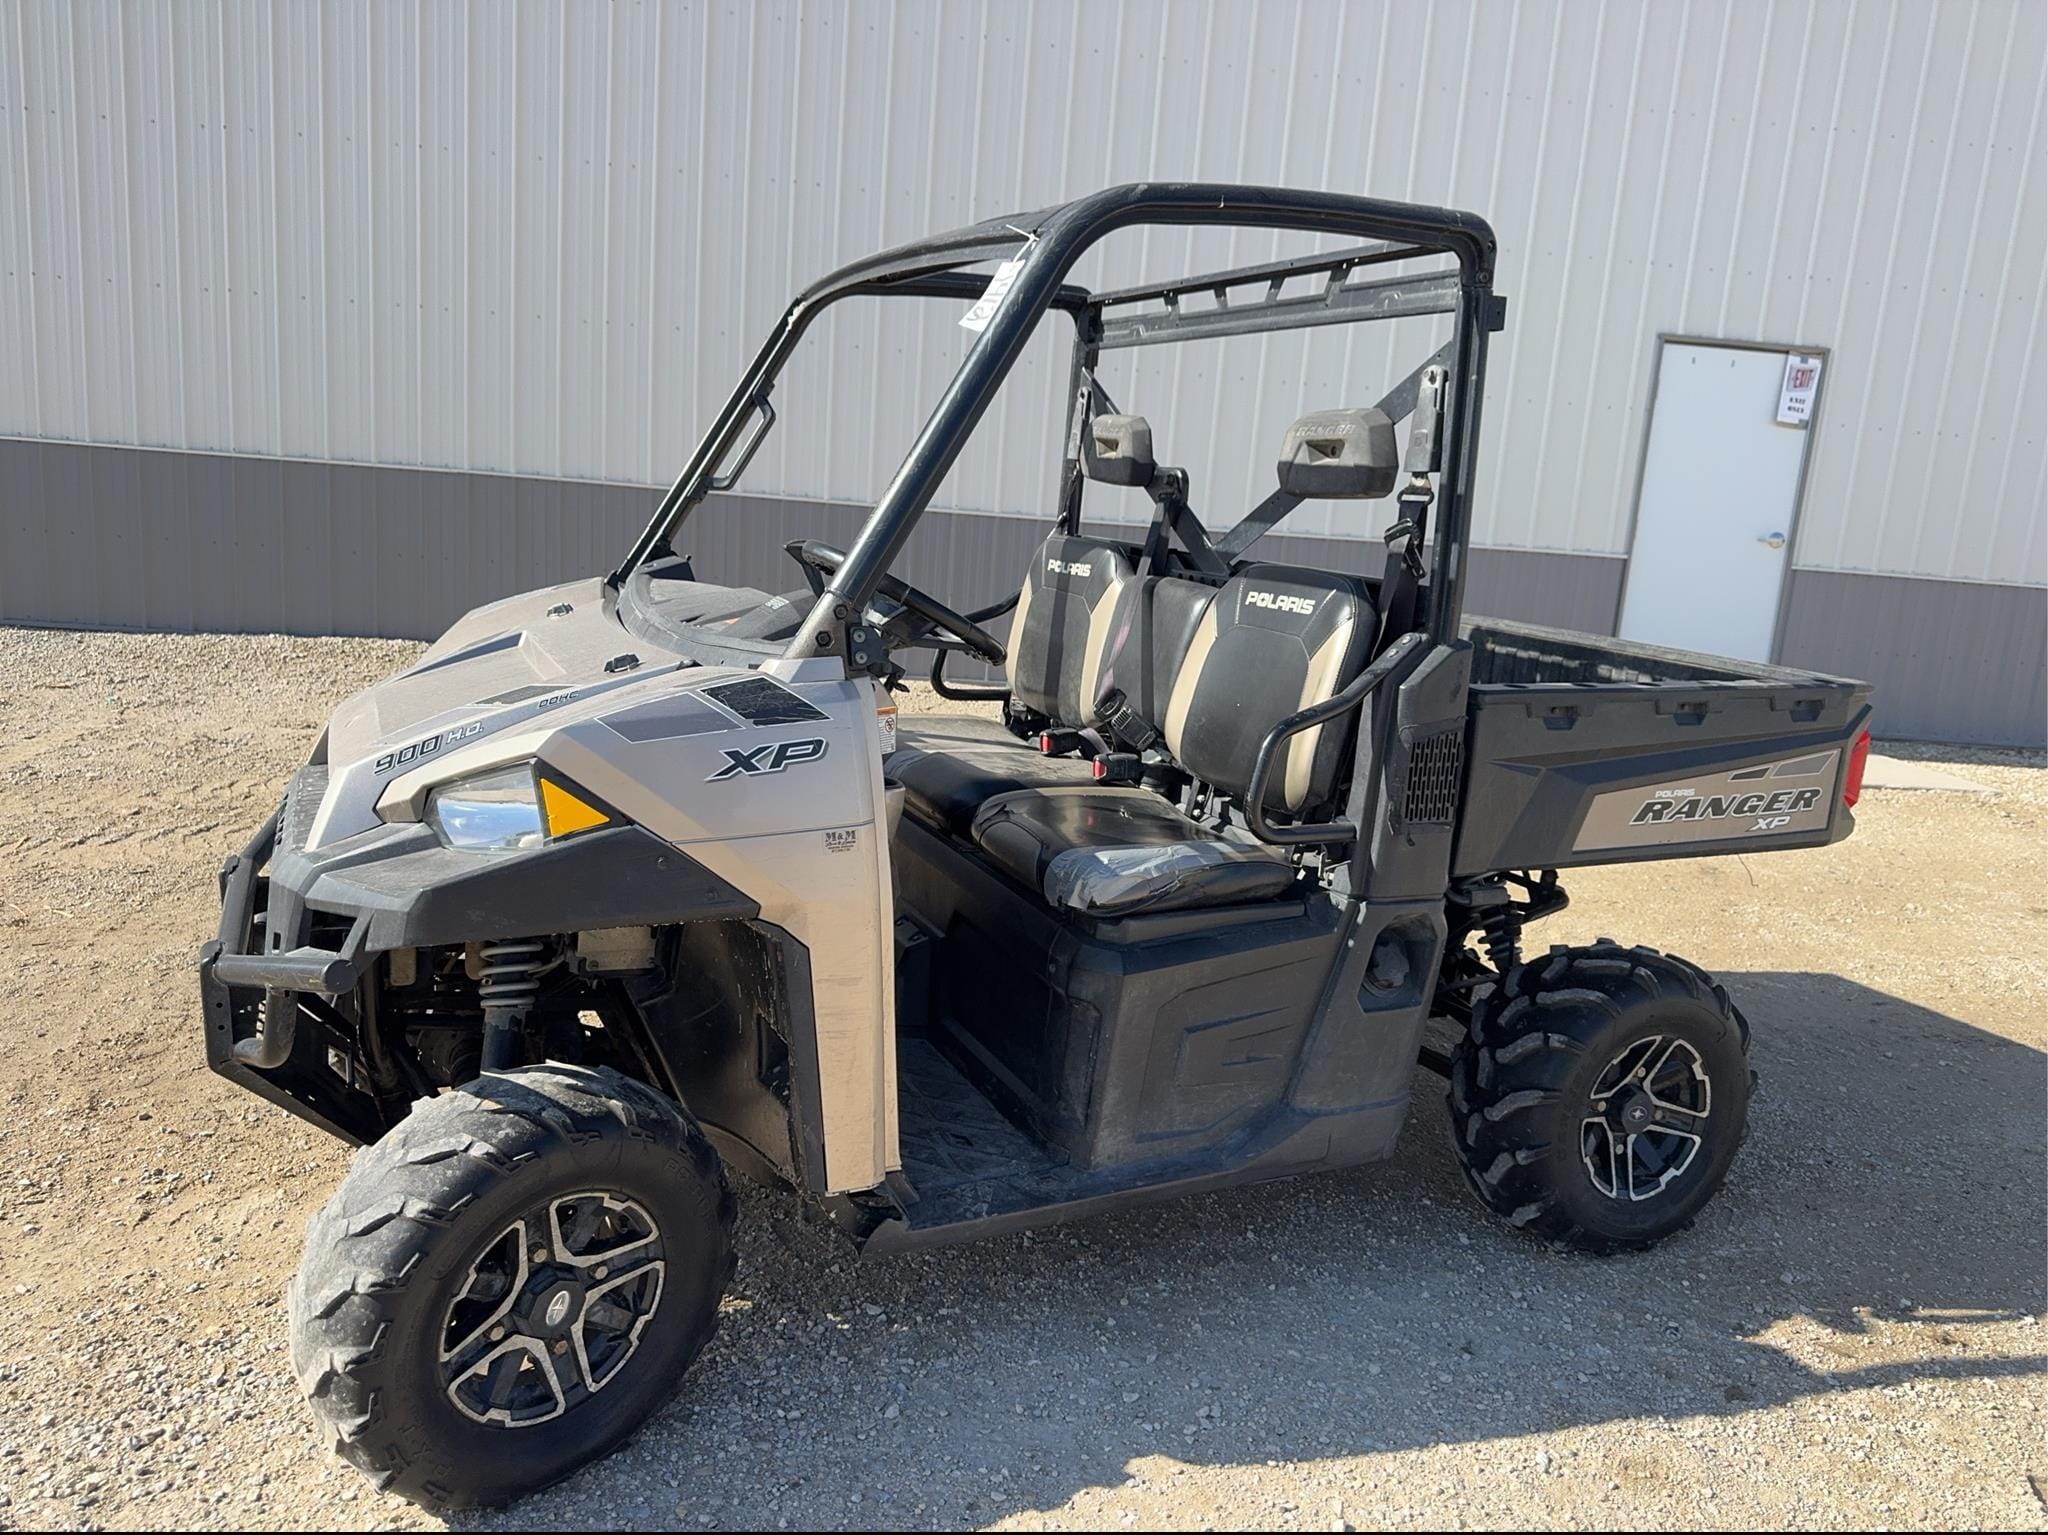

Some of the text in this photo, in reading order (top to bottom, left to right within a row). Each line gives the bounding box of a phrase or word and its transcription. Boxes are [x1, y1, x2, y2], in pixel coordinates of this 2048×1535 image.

[1793, 368, 1814, 388] EXIT
[1296, 424, 1356, 437] RANGER
[1047, 559, 1092, 577] POLARIS
[1245, 591, 1316, 615] POLARIS
[537, 691, 579, 709] DOHC
[373, 734, 444, 776] 900
[703, 737, 828, 783] XP
[1655, 788, 1696, 799] POLARIS
[1628, 787, 1823, 826] RANGER
[1750, 815, 1792, 831] XP
